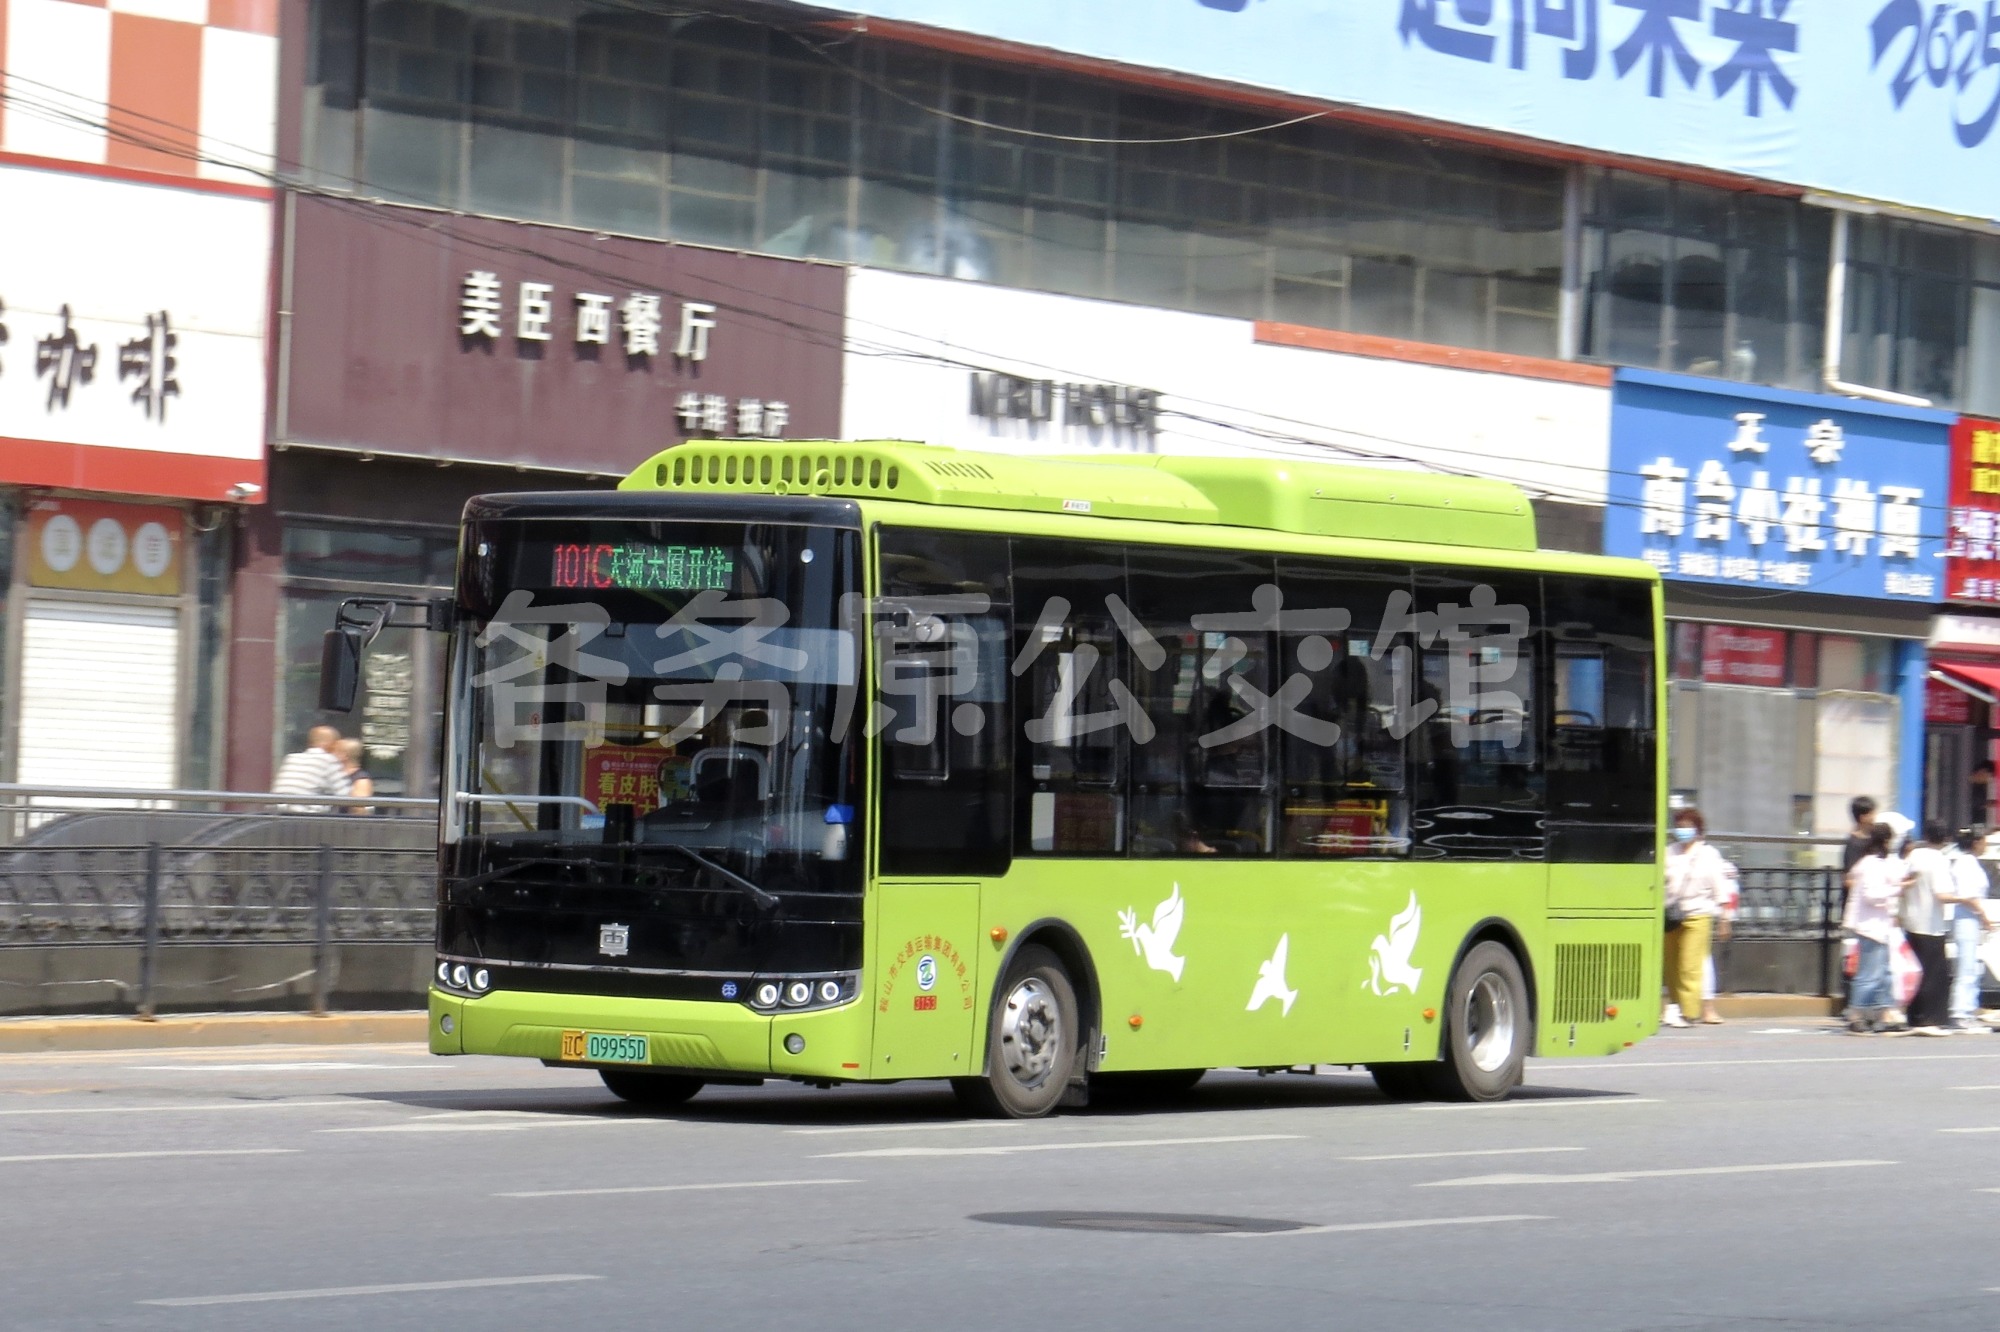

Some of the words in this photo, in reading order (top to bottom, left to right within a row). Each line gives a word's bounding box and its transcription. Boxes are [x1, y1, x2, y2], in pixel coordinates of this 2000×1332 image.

[461, 270, 717, 361] 美臣西餐厅
[0, 297, 180, 424] 咖啡
[676, 392, 728, 433] 牛排
[1727, 412, 1846, 464] 正宗
[554, 544, 613, 588] 101C
